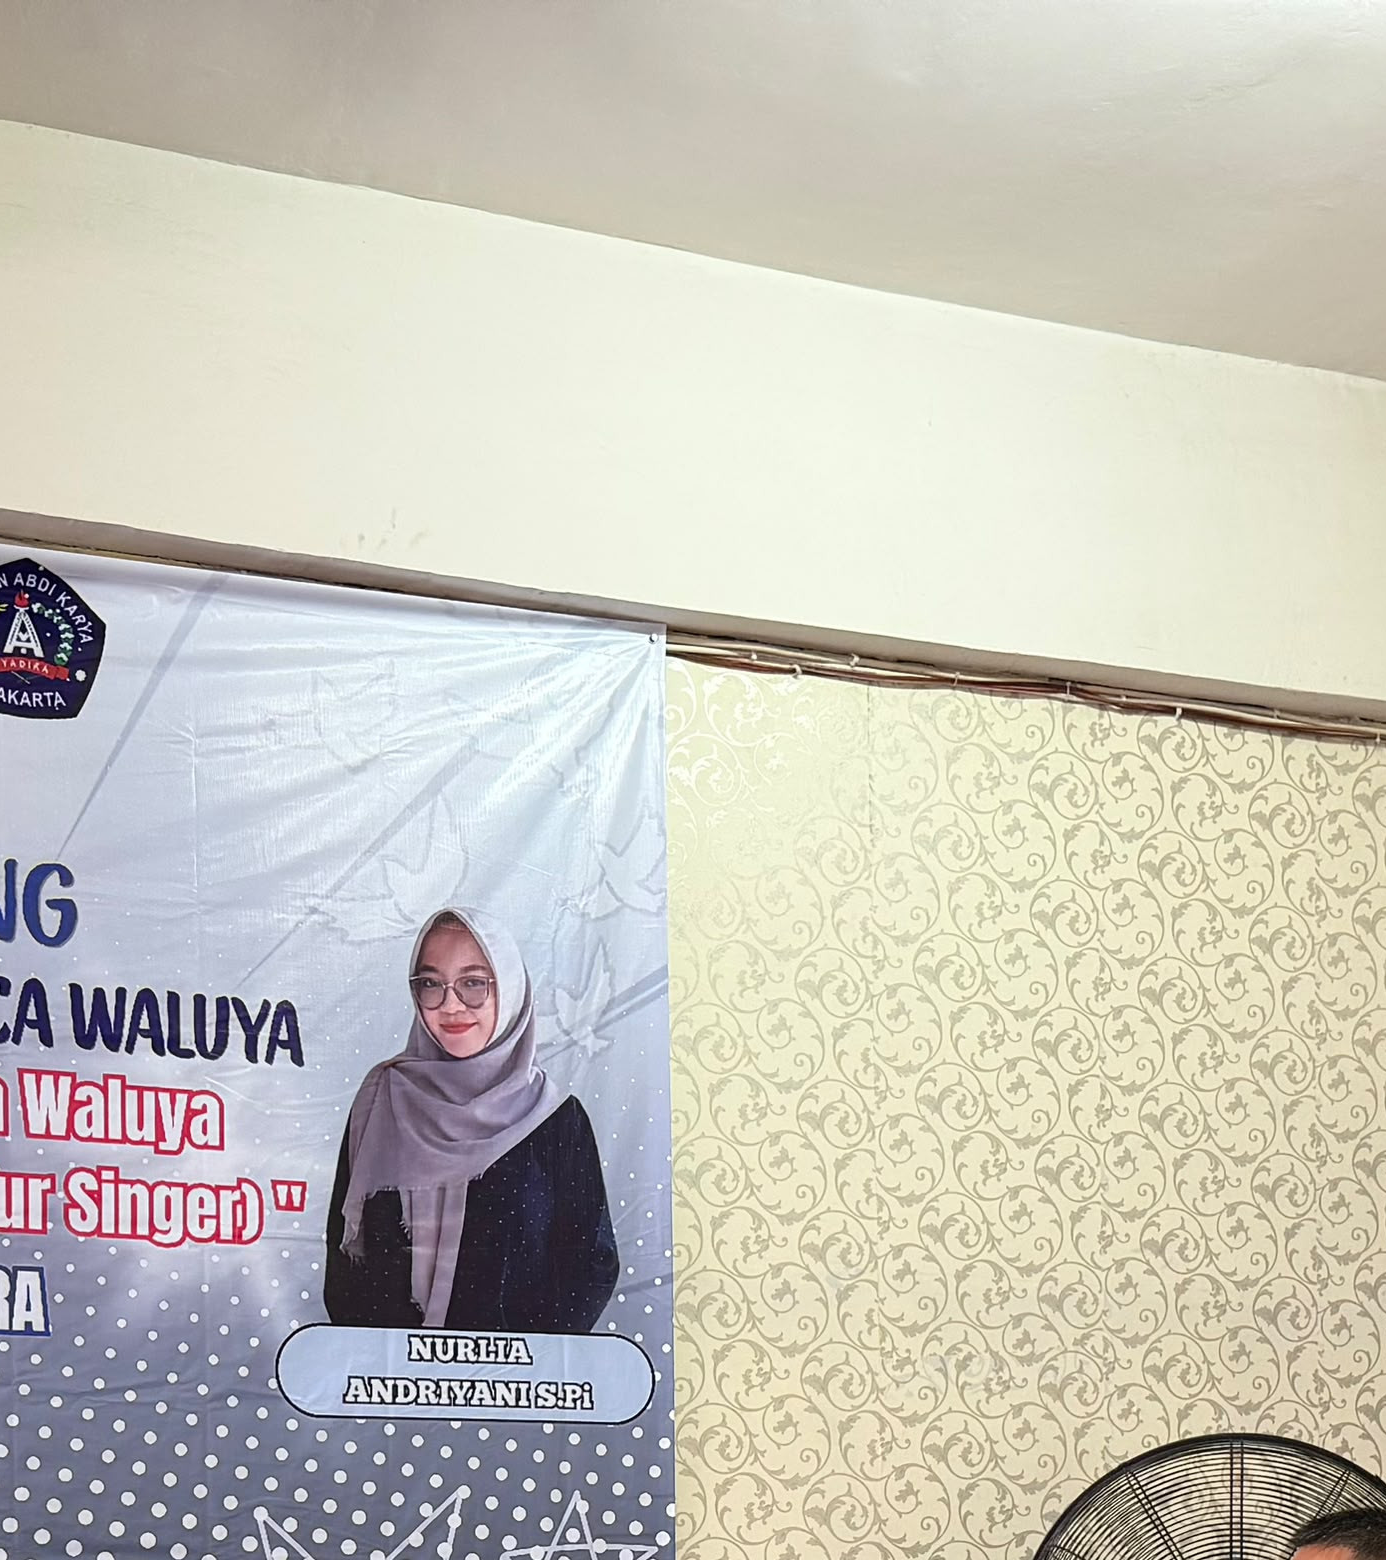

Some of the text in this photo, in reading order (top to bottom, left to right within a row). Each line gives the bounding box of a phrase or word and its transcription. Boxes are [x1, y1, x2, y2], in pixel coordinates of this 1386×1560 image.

[13, 572, 57, 597] ABDI
[56, 591, 94, 644] KARYA
[0, 658, 49, 675] YADIKA
[69, 982, 305, 1067] WALUYA
[17, 1067, 226, 1156] Waluya
[63, 1165, 266, 1249] Singer)
[408, 1333, 533, 1365] NURLIA
[343, 1376, 533, 1408] ANDRIYANI
